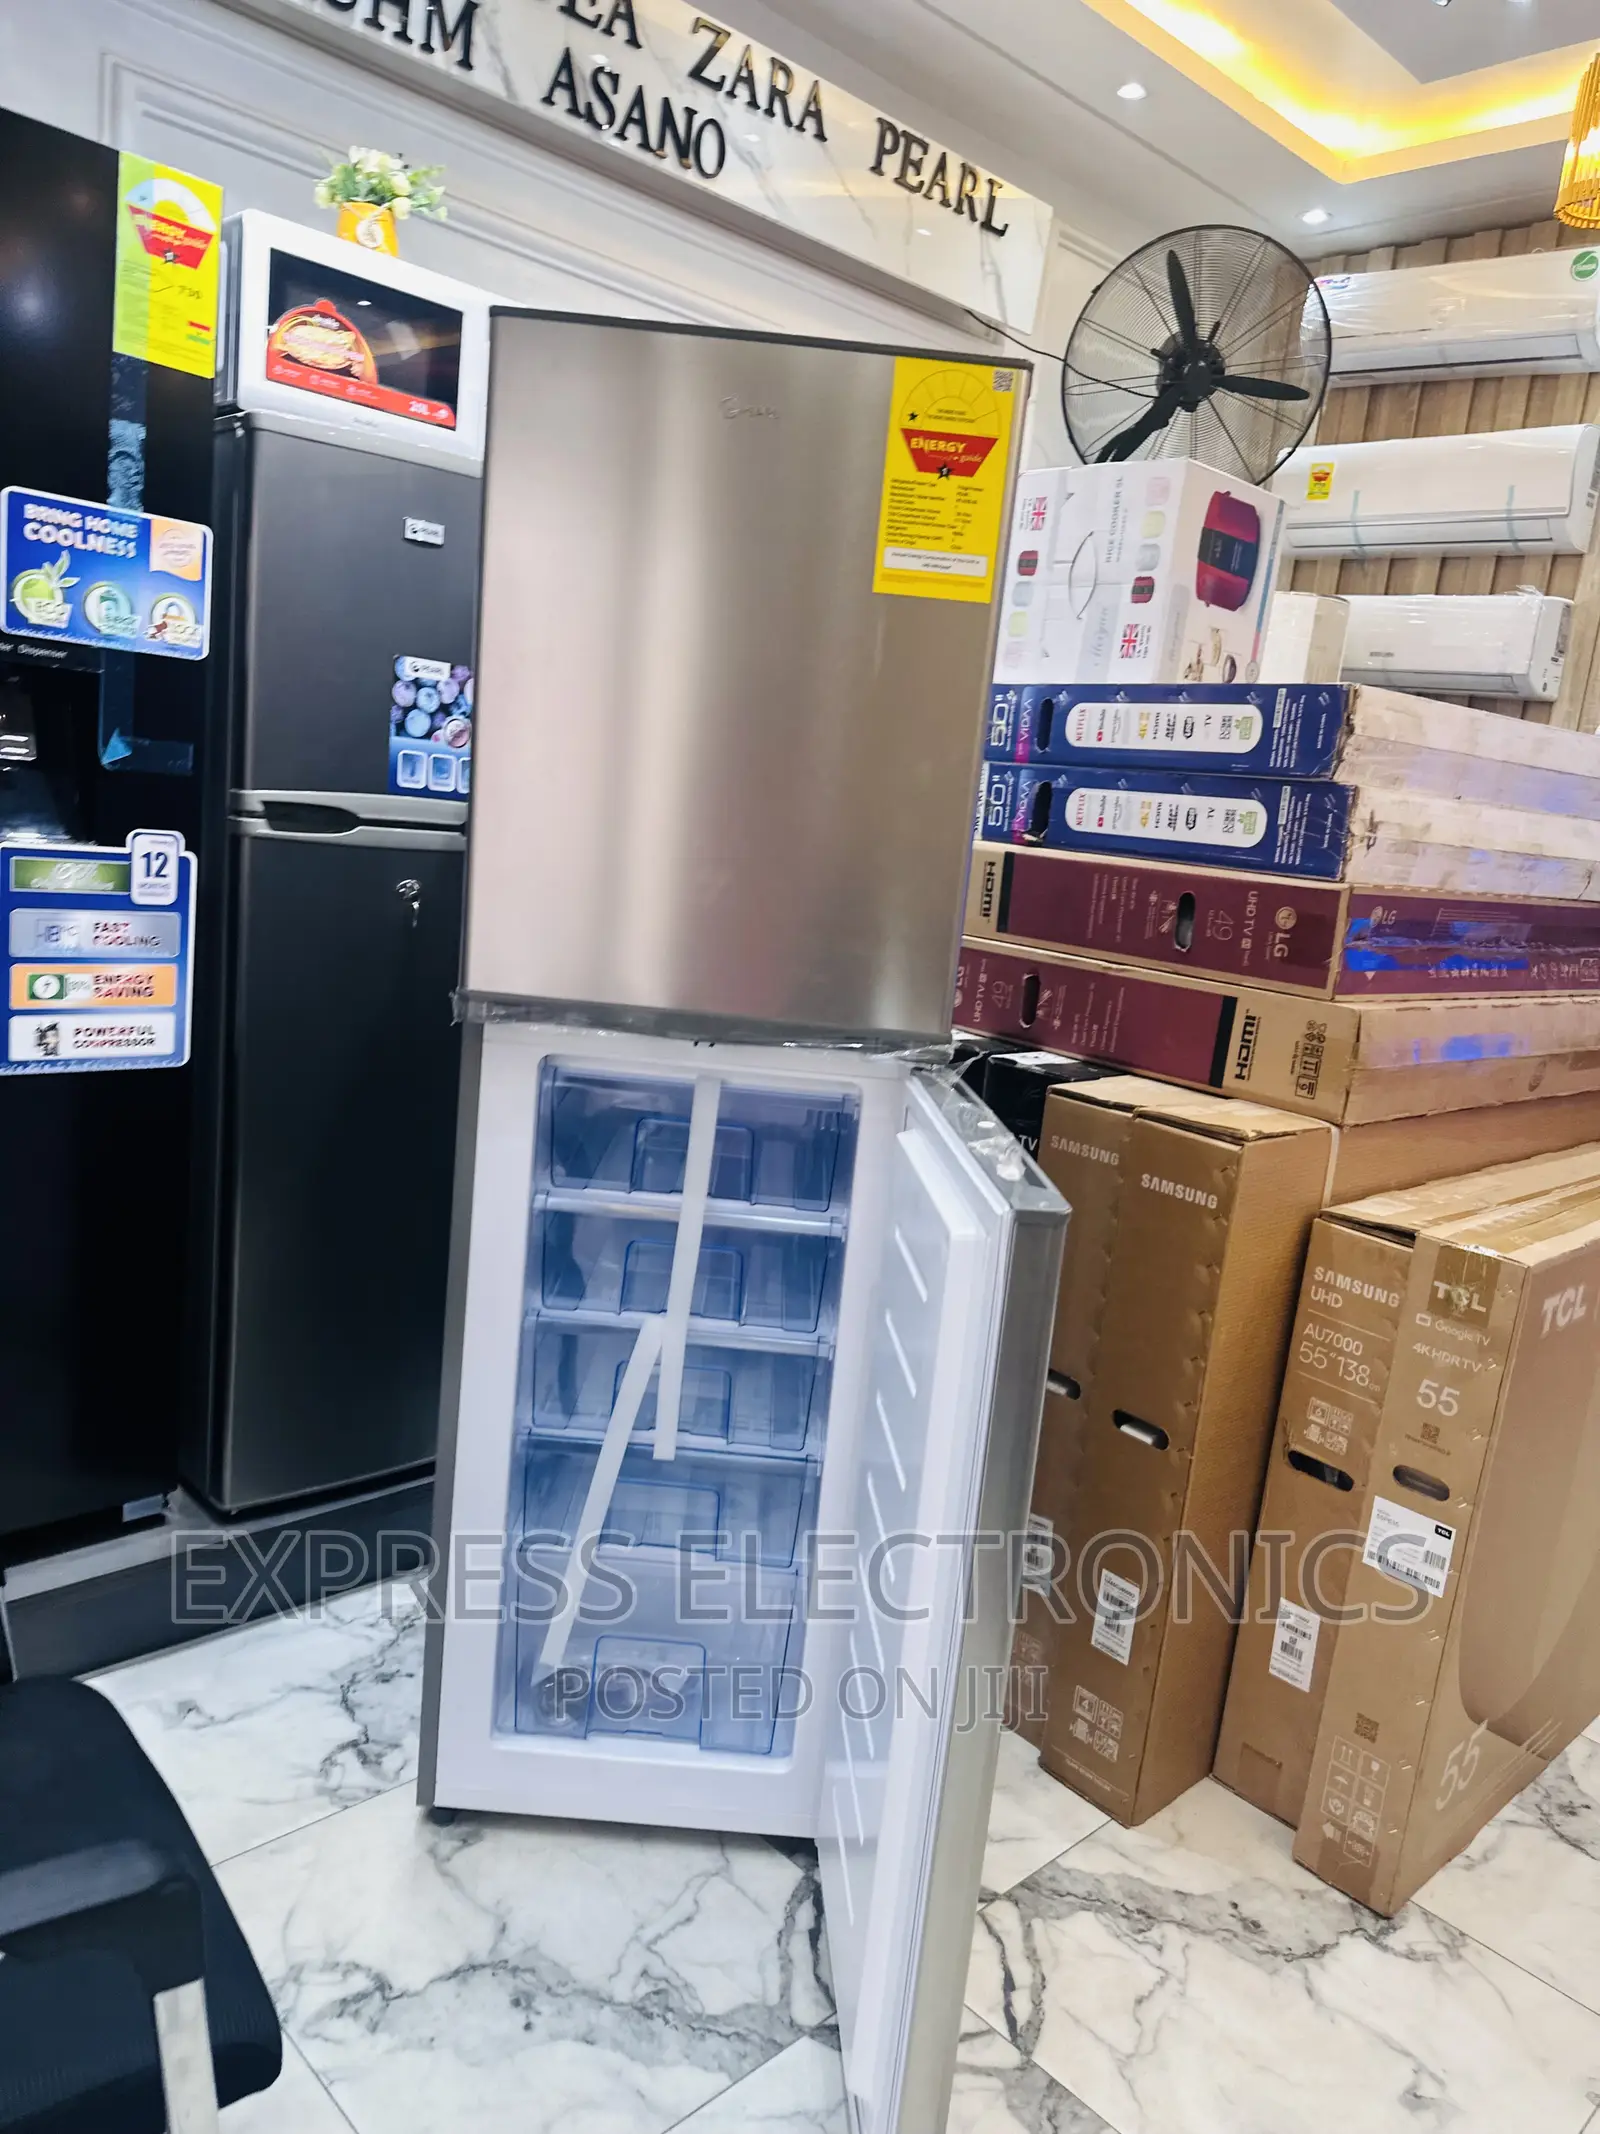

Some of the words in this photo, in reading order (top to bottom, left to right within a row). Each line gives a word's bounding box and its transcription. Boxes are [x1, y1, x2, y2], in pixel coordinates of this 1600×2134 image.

[542, 46, 726, 179] ASANO
[688, 17, 828, 142] ZARA
[870, 117, 1009, 237] PEARL
[910, 438, 967, 453] ENERGY
[24, 503, 83, 528] BRING
[85, 515, 138, 538] HOME
[24, 521, 137, 559] COOLNESS
[1076, 708, 1086, 741] NETFLIX
[988, 775, 1006, 826] 50"
[1076, 794, 1086, 826] NETFLIX
[140, 850, 169, 879] 12
[982, 861, 997, 918] HDMI
[1246, 891, 1258, 916] UHD
[1381, 909, 1397, 925] LG
[93, 921, 131, 934] FAST
[1212, 910, 1233, 940] 49
[1243, 920, 1254, 936] TV
[93, 936, 162, 947] COOLING
[1273, 932, 1291, 958] LG
[93, 987, 155, 999] SAVING
[94, 974, 155, 986] ENERGY
[977, 985, 985, 998] TV
[991, 981, 1007, 1007] 49
[973, 1001, 983, 1022] UHD
[73, 1037, 156, 1049] COMPRESSOR
[74, 1024, 156, 1038] POWERFUL
[1235, 1015, 1256, 1080] HDMI
[1018, 1134, 1040, 1151] TV
[1050, 1134, 1120, 1166] SAMSUNG
[1141, 1174, 1218, 1210] SAMSUNG
[1311, 1285, 1343, 1308] UHD
[1313, 1266, 1400, 1308] SAMSUNG
[1539, 1284, 1588, 1340] TCL
[1303, 1323, 1363, 1356] AU7000
[1434, 1319, 1473, 1341] Google
[1474, 1334, 1491, 1346] TV
[1412, 1342, 1430, 1356] 4K
[1416, 1378, 1461, 1417] 55
[1437, 1527, 1450, 1537] TCL
[1435, 1719, 1488, 1812] 55
